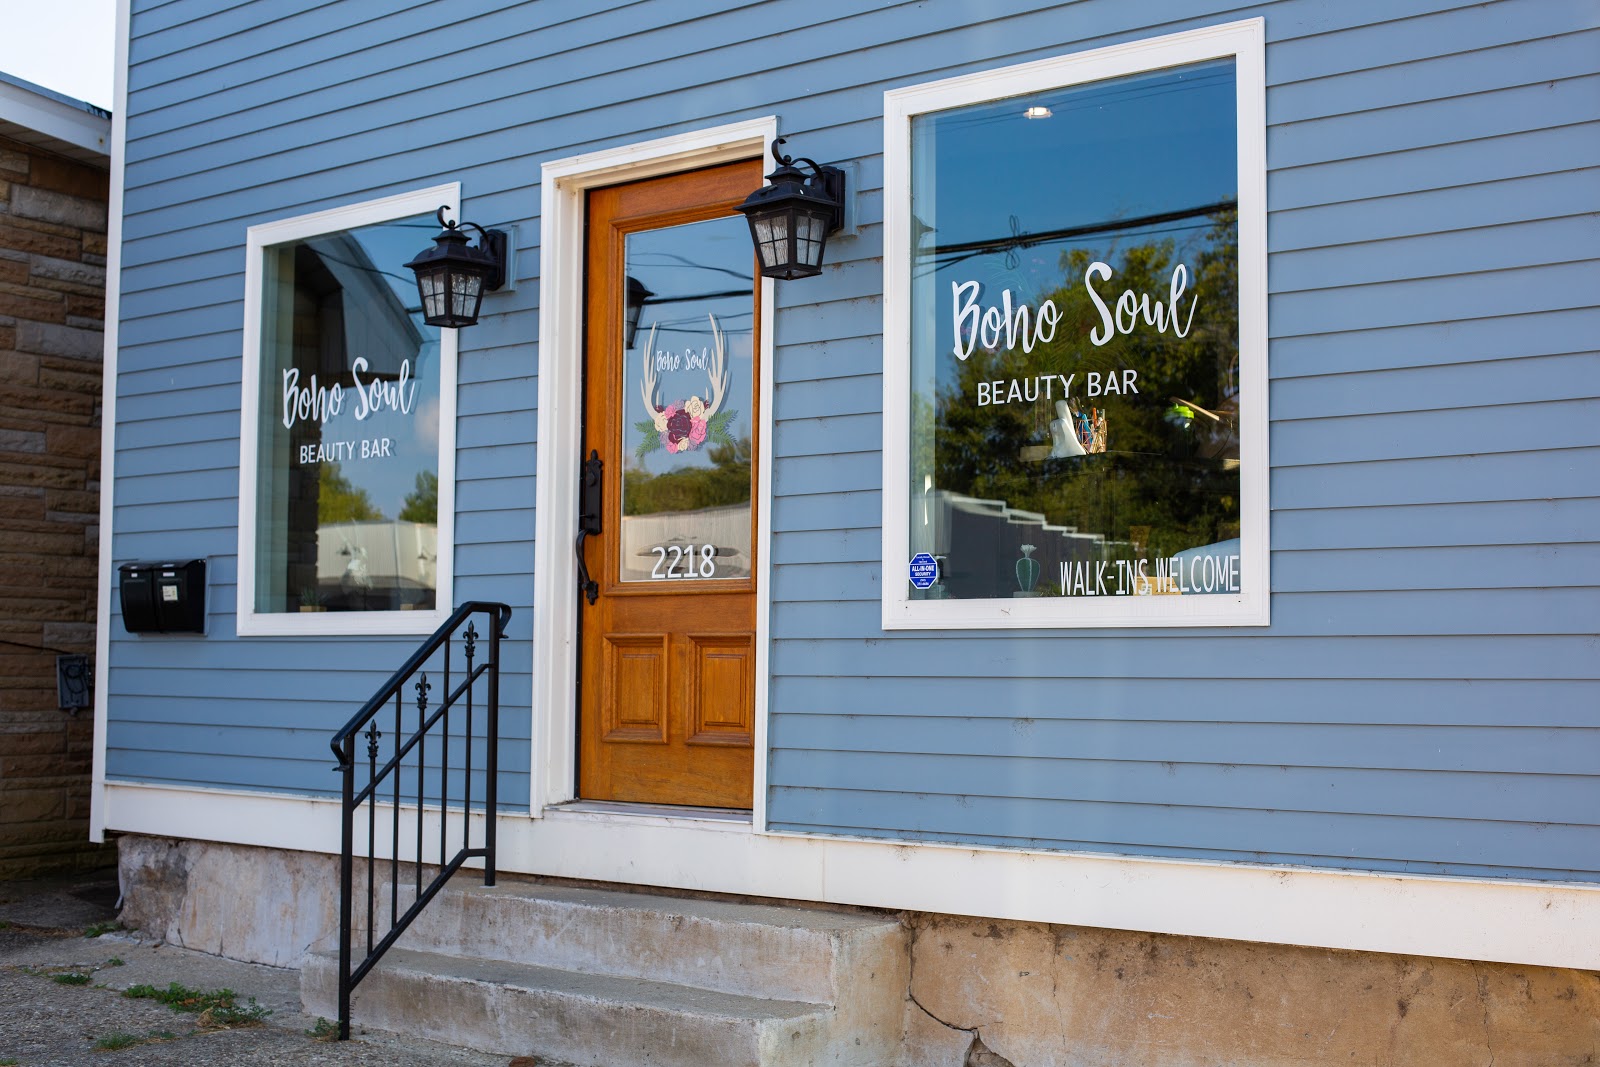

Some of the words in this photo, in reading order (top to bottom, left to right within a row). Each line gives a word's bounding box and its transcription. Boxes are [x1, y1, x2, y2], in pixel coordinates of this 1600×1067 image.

[952, 280, 1063, 361] Boho
[1084, 261, 1198, 347] Soul
[656, 350, 680, 372] Boho
[685, 347, 709, 371] Soul
[282, 367, 346, 429] Boho
[352, 356, 416, 421] Soul
[977, 373, 1075, 407] BEAUTY
[1087, 369, 1139, 397] BAR
[299, 440, 356, 464] BEAUTY
[361, 438, 391, 459] BAR
[651, 544, 715, 579] 2218
[1060, 558, 1149, 596] WALK-INS
[1155, 555, 1240, 593] WELCOME
